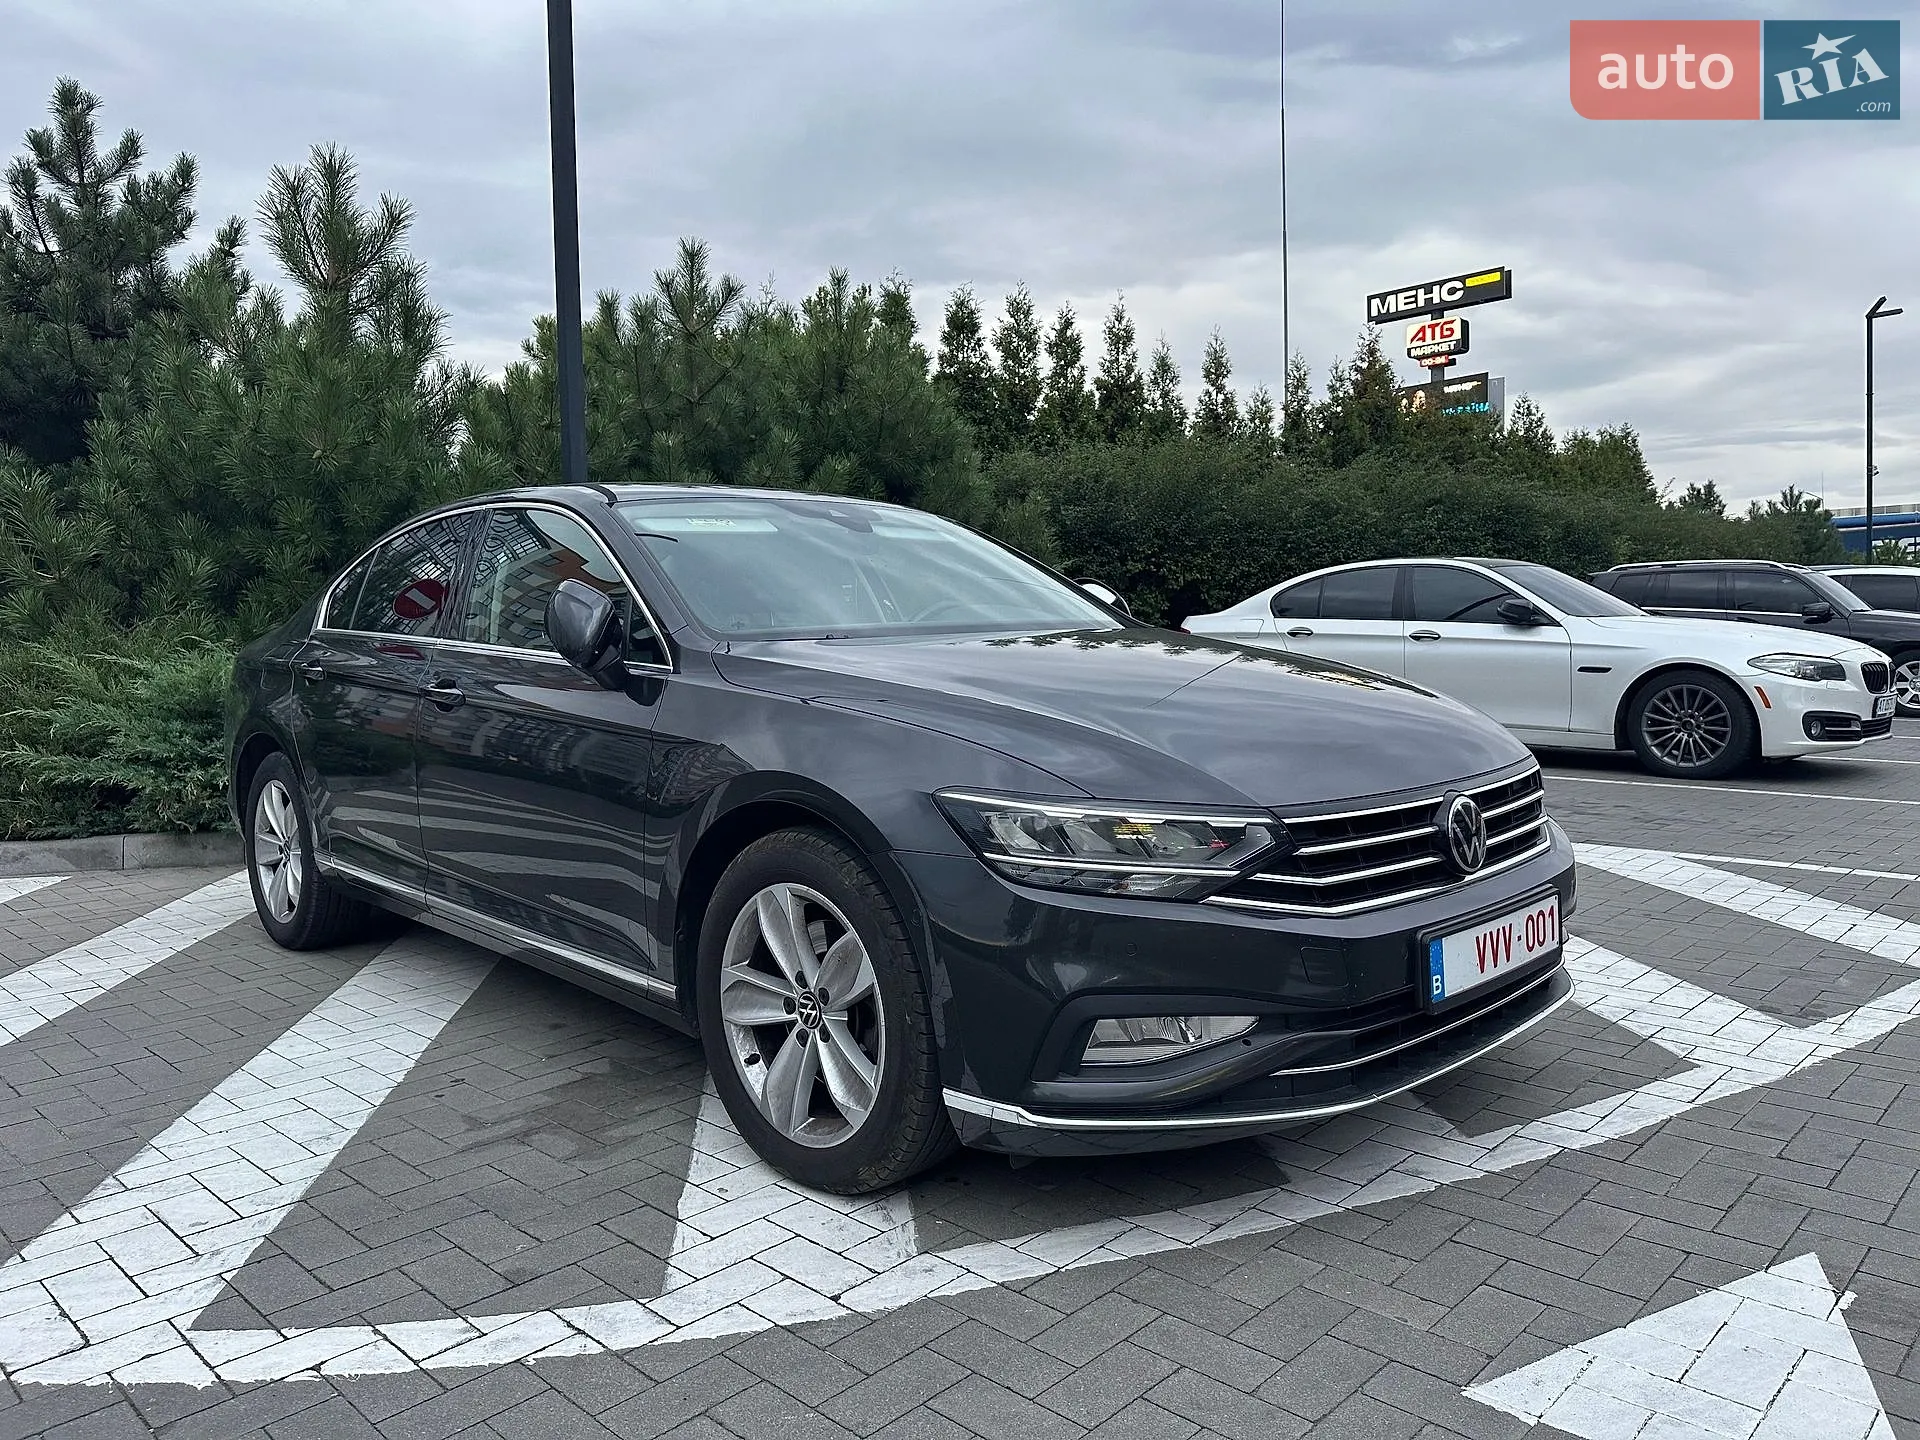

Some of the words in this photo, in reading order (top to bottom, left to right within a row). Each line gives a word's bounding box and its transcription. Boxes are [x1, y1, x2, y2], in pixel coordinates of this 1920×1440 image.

[1370, 280, 1465, 317] МЕНС
[1410, 319, 1457, 344] АТБ
[1411, 341, 1457, 357] МАРКЕТ
[1475, 905, 1556, 974] VVV-001
[1432, 974, 1443, 995] B
